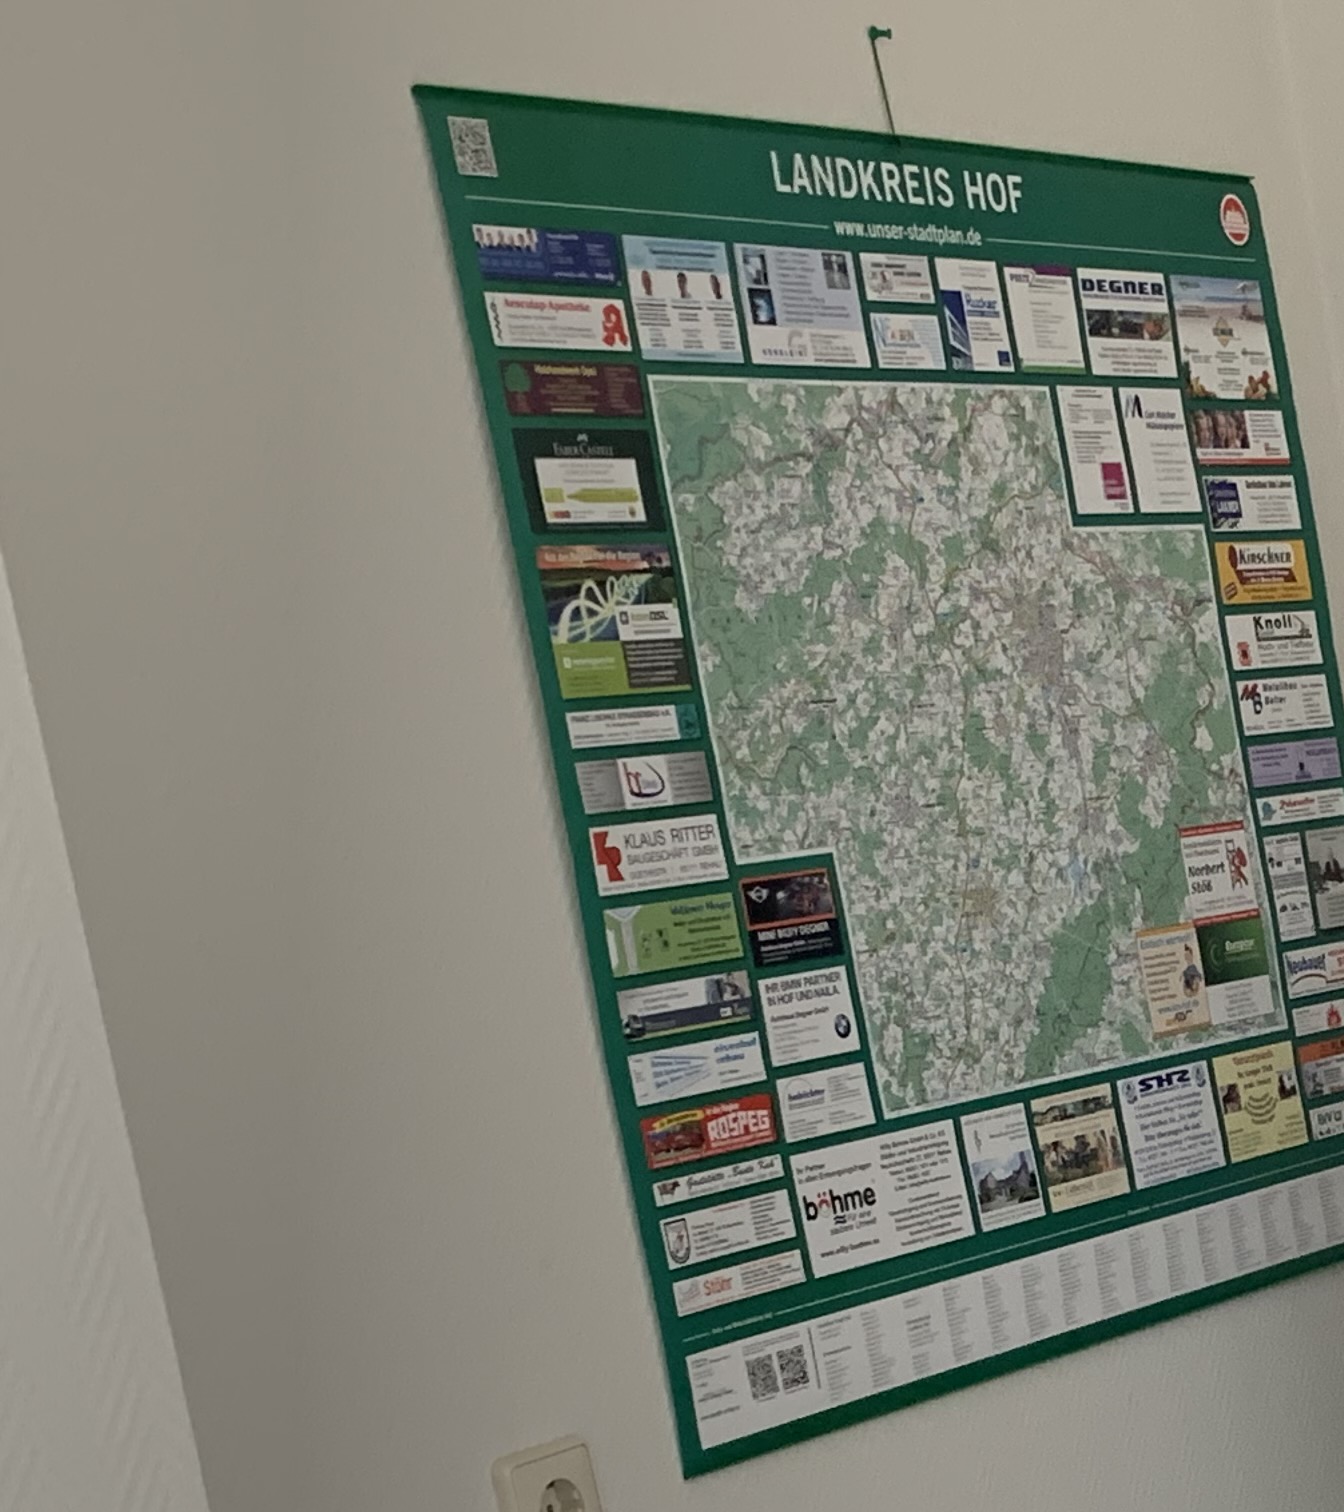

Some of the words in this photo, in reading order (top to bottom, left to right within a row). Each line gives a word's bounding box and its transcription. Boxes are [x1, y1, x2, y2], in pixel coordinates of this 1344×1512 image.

[769, 150, 954, 208] LANDKREIS
[966, 173, 1023, 214] HOF
[833, 219, 982, 247] www.unser-stadtplan.de
[1080, 278, 1165, 296] DEGNER
[1253, 614, 1293, 631] Knoll
[624, 829, 666, 849] KLAUS
[671, 823, 716, 843] RITTER
[1188, 861, 1226, 878] Norbert
[802, 1185, 877, 1222] böhme
